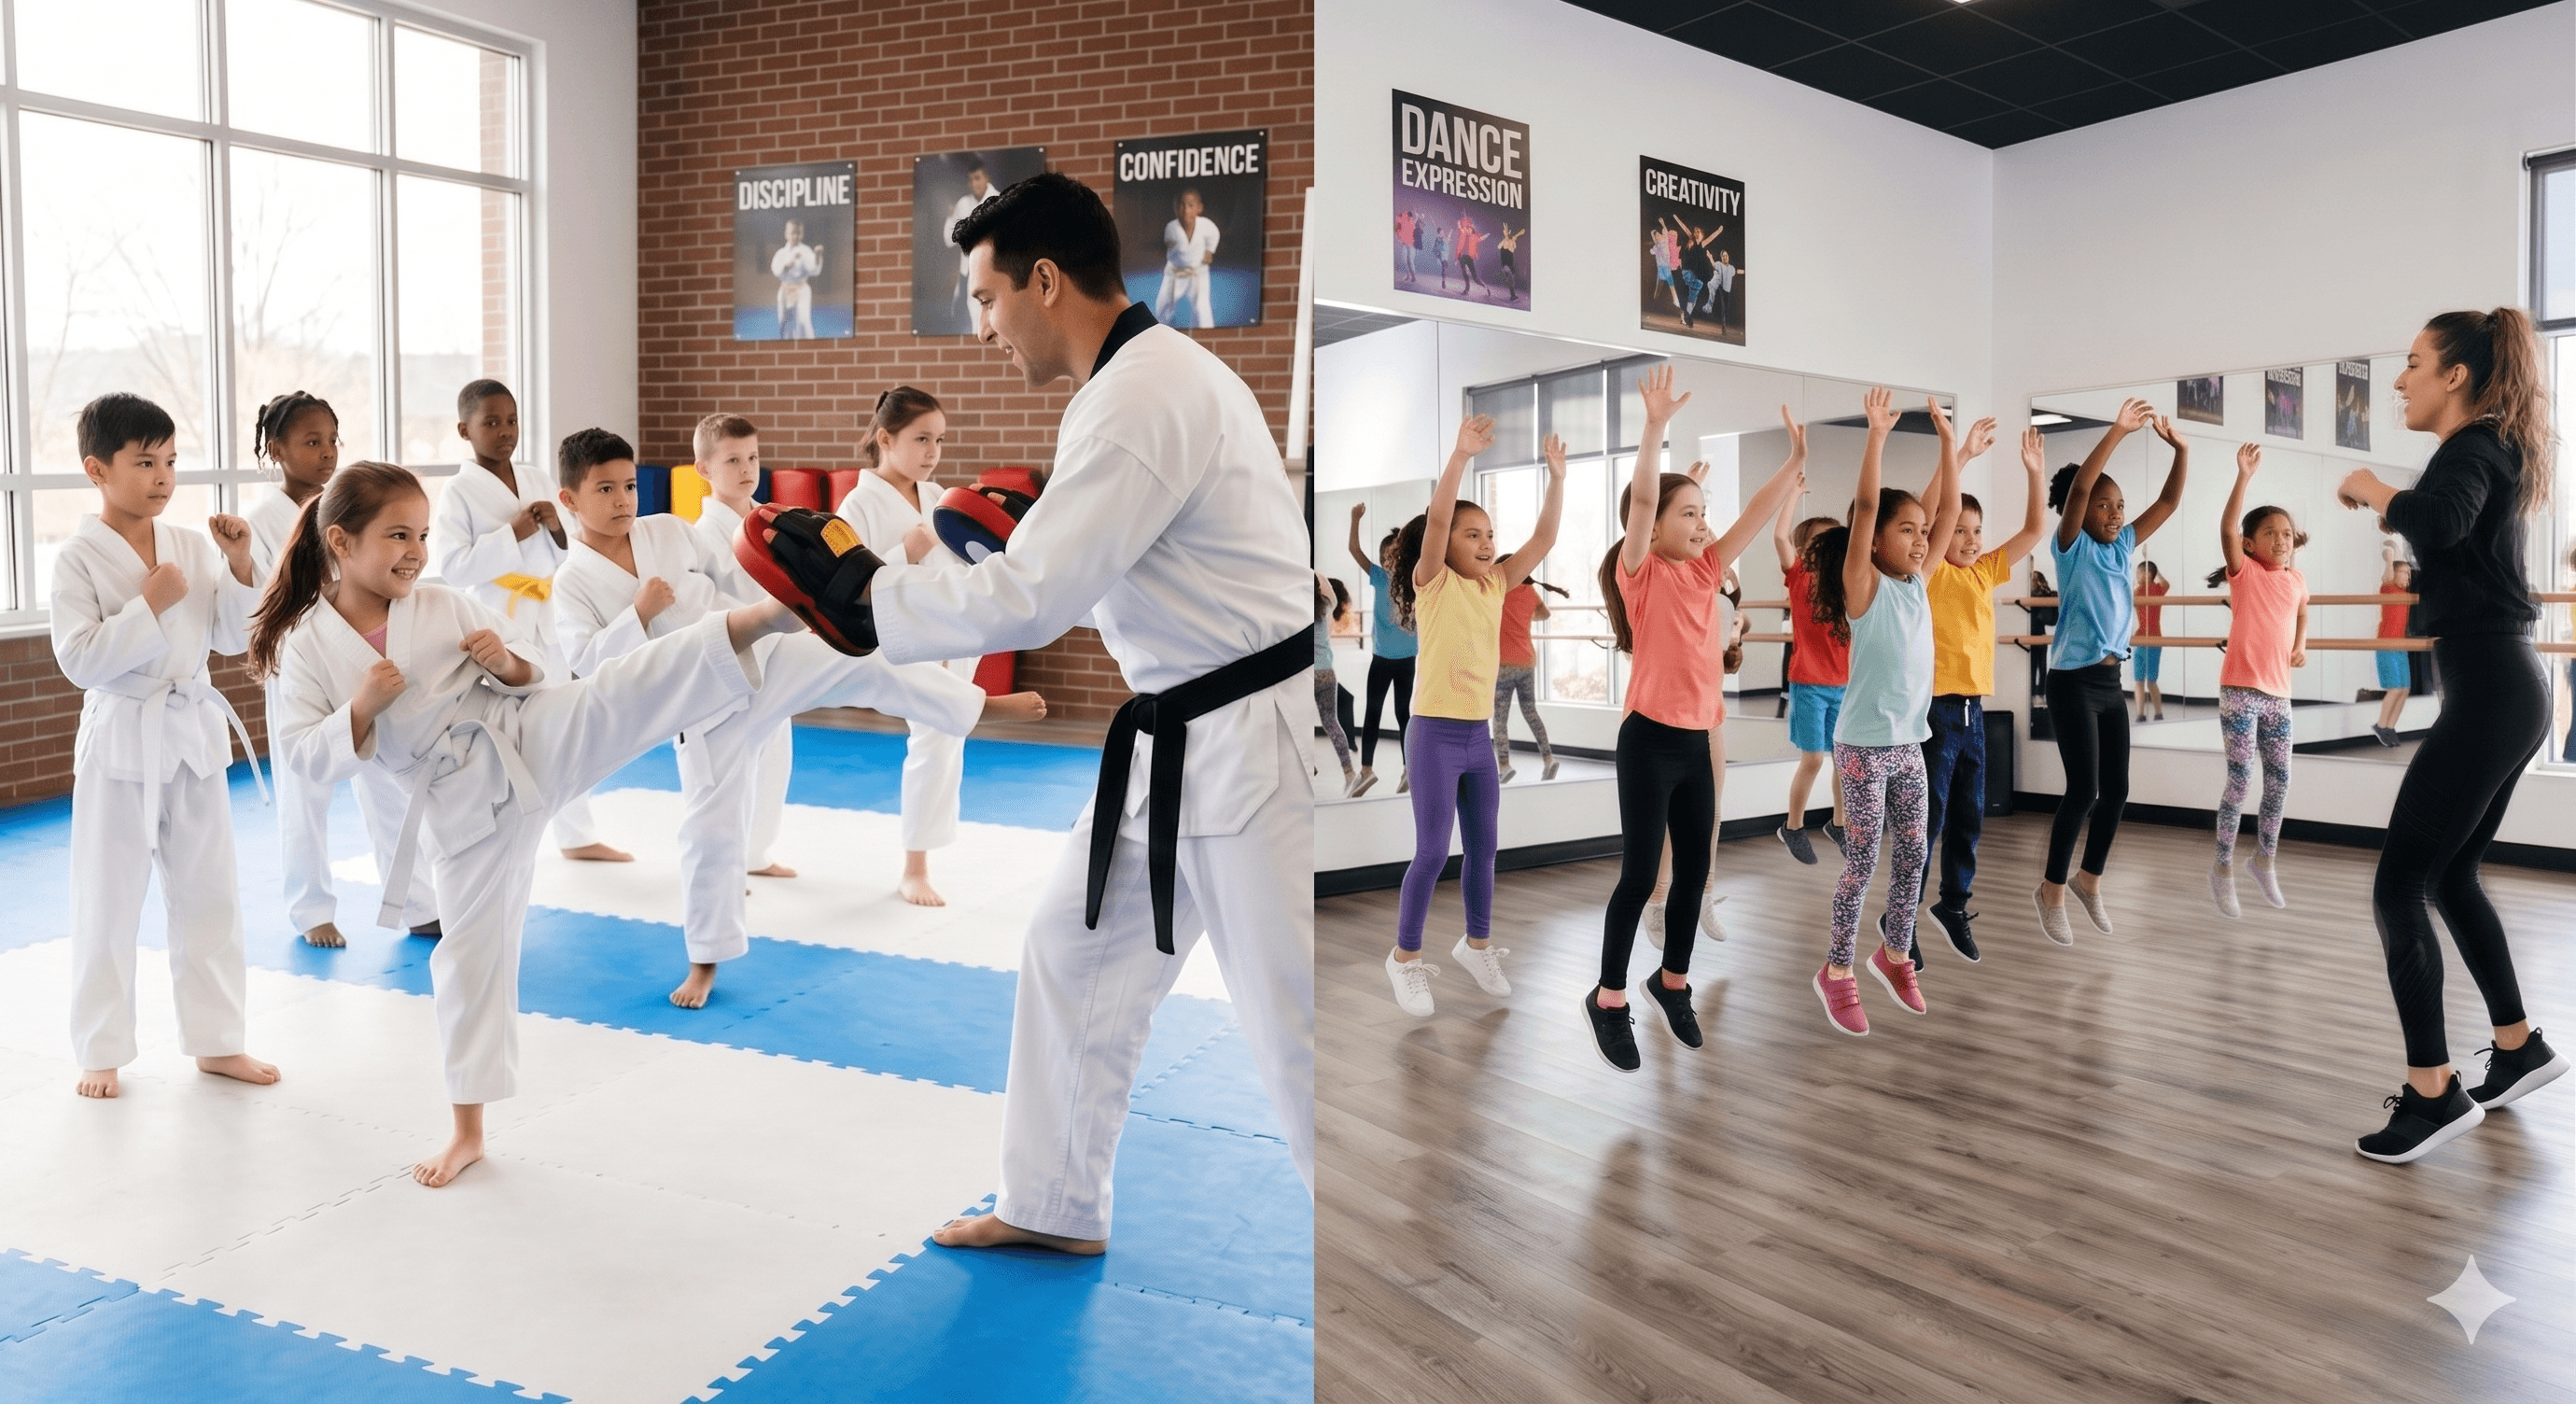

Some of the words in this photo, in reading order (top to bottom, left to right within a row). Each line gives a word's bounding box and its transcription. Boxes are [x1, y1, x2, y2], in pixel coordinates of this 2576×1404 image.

[1119, 143, 1260, 182] CONFIDENCE
[1401, 103, 1522, 179] DANCE
[738, 175, 850, 210] DISCIPLINE
[1401, 158, 1522, 209] EXPRESSION
[1645, 168, 1741, 217] CREATIVITY
